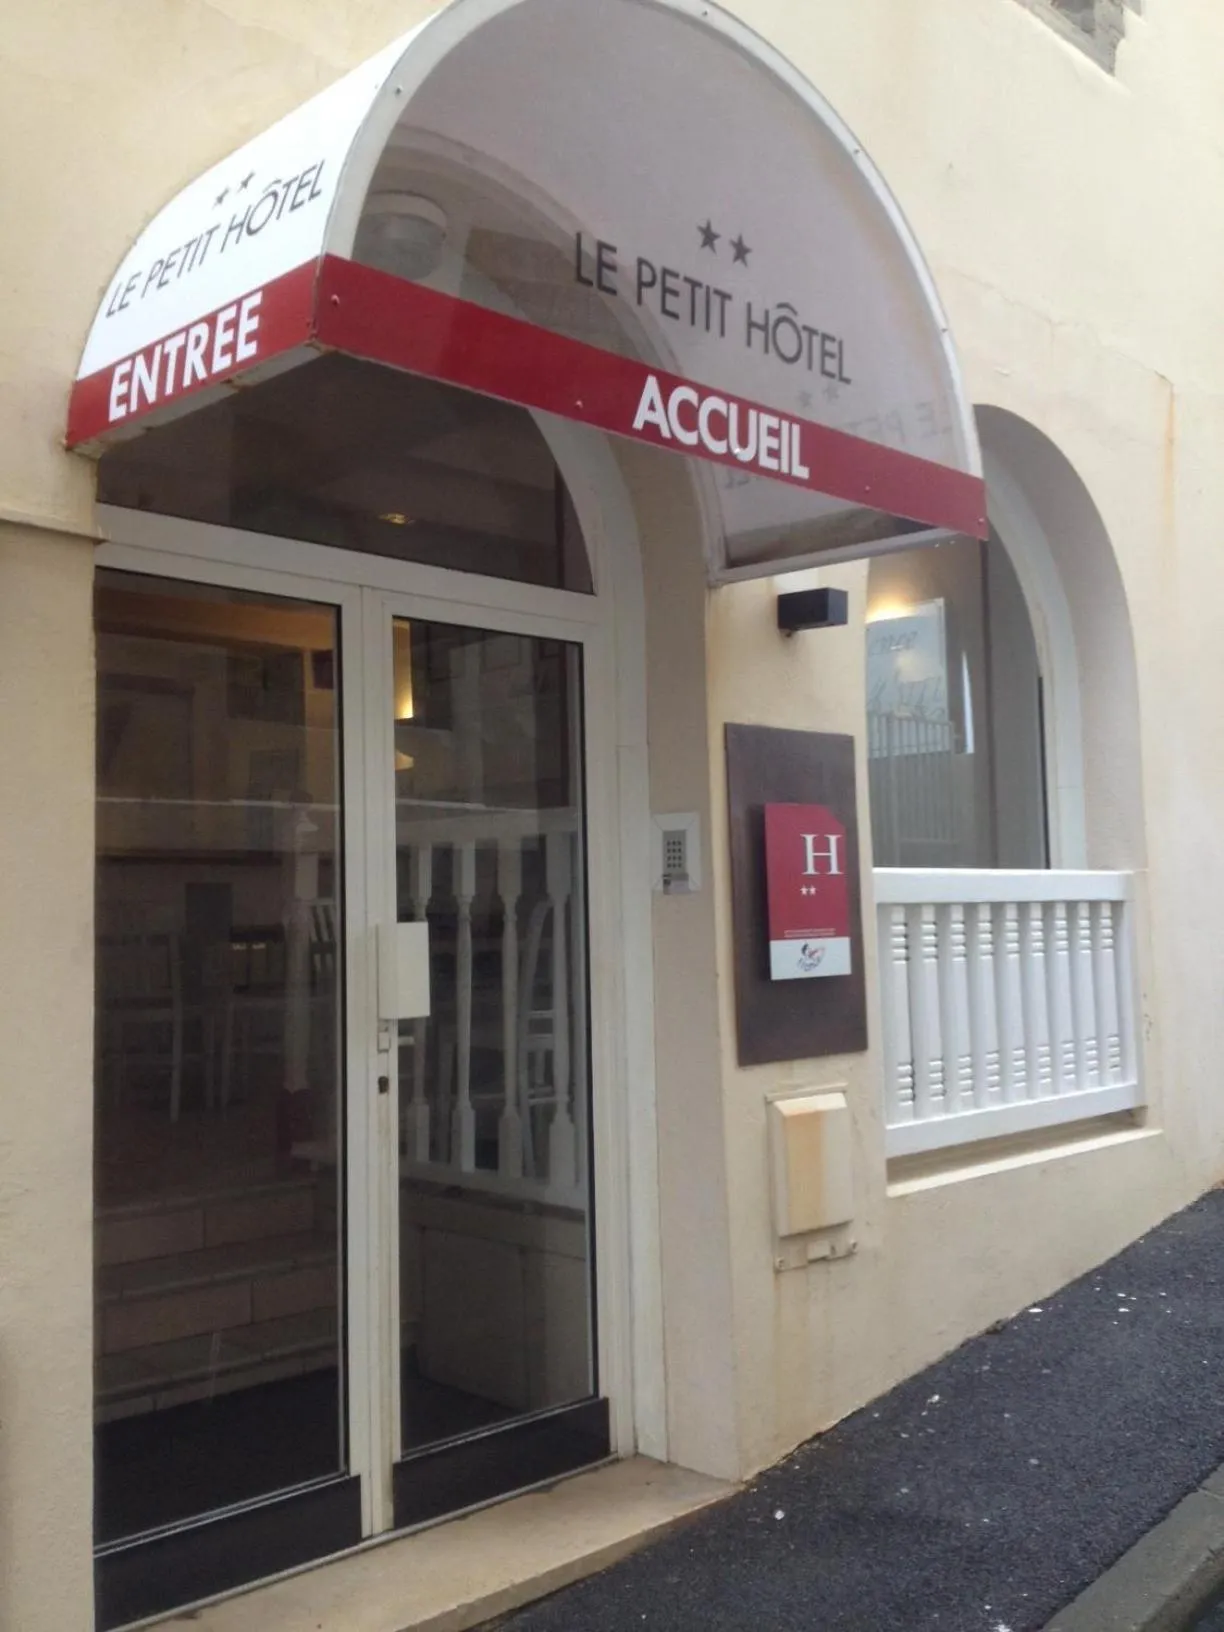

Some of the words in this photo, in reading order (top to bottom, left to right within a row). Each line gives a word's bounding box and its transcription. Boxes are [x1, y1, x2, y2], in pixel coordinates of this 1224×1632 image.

[105, 271, 142, 318] LE
[140, 223, 221, 298] PETIT
[219, 159, 326, 254] HÔTEL
[108, 291, 263, 423] ENTREE
[575, 231, 618, 296] LE
[636, 256, 733, 338] PETIT
[746, 302, 852, 385] HÔTEL
[632, 374, 809, 479] ACCUEIL
[801, 833, 843, 875] H
